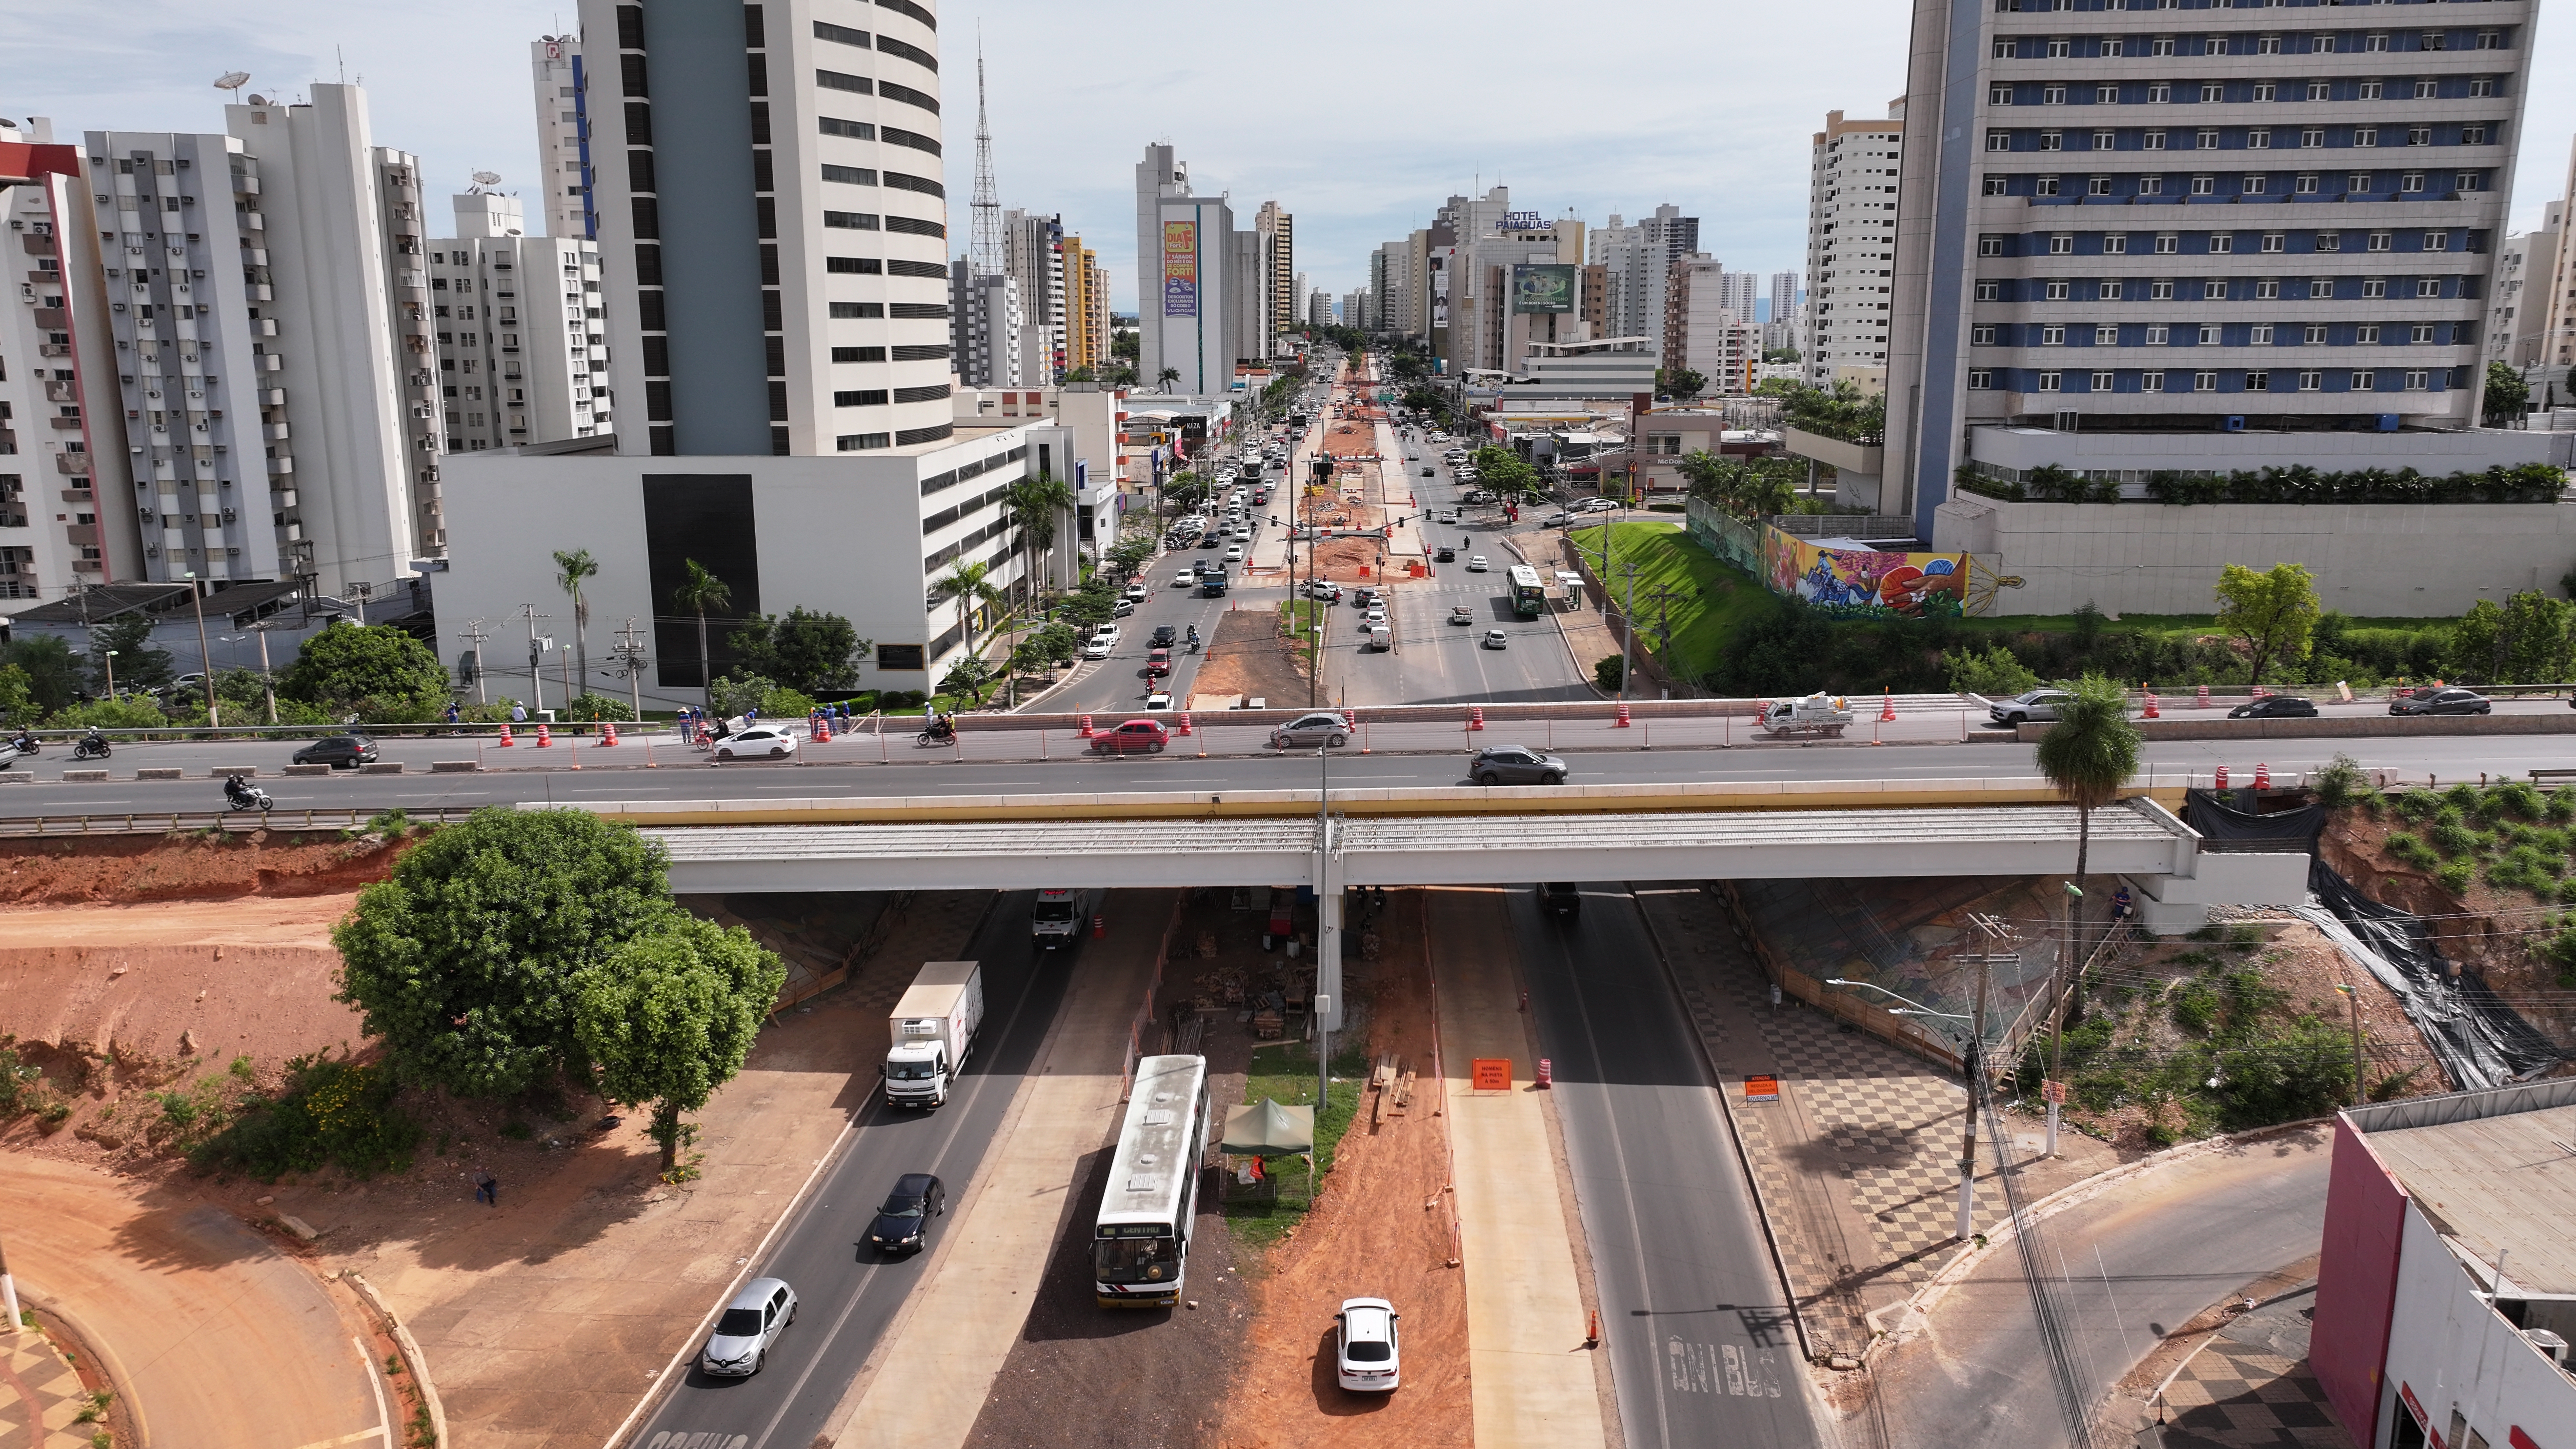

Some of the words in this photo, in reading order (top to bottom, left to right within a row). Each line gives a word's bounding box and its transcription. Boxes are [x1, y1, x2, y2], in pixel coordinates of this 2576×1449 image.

[1504, 212, 1541, 221] HOTEL
[1495, 221, 1551, 230] PAIAGUAS
[1167, 233, 1182, 242] DIA
[2042, 1084, 2064, 1093] CALDAS
[2043, 1089, 2062, 1098] NOVAS
[1669, 1334, 1781, 1398] ÔNIBUS
